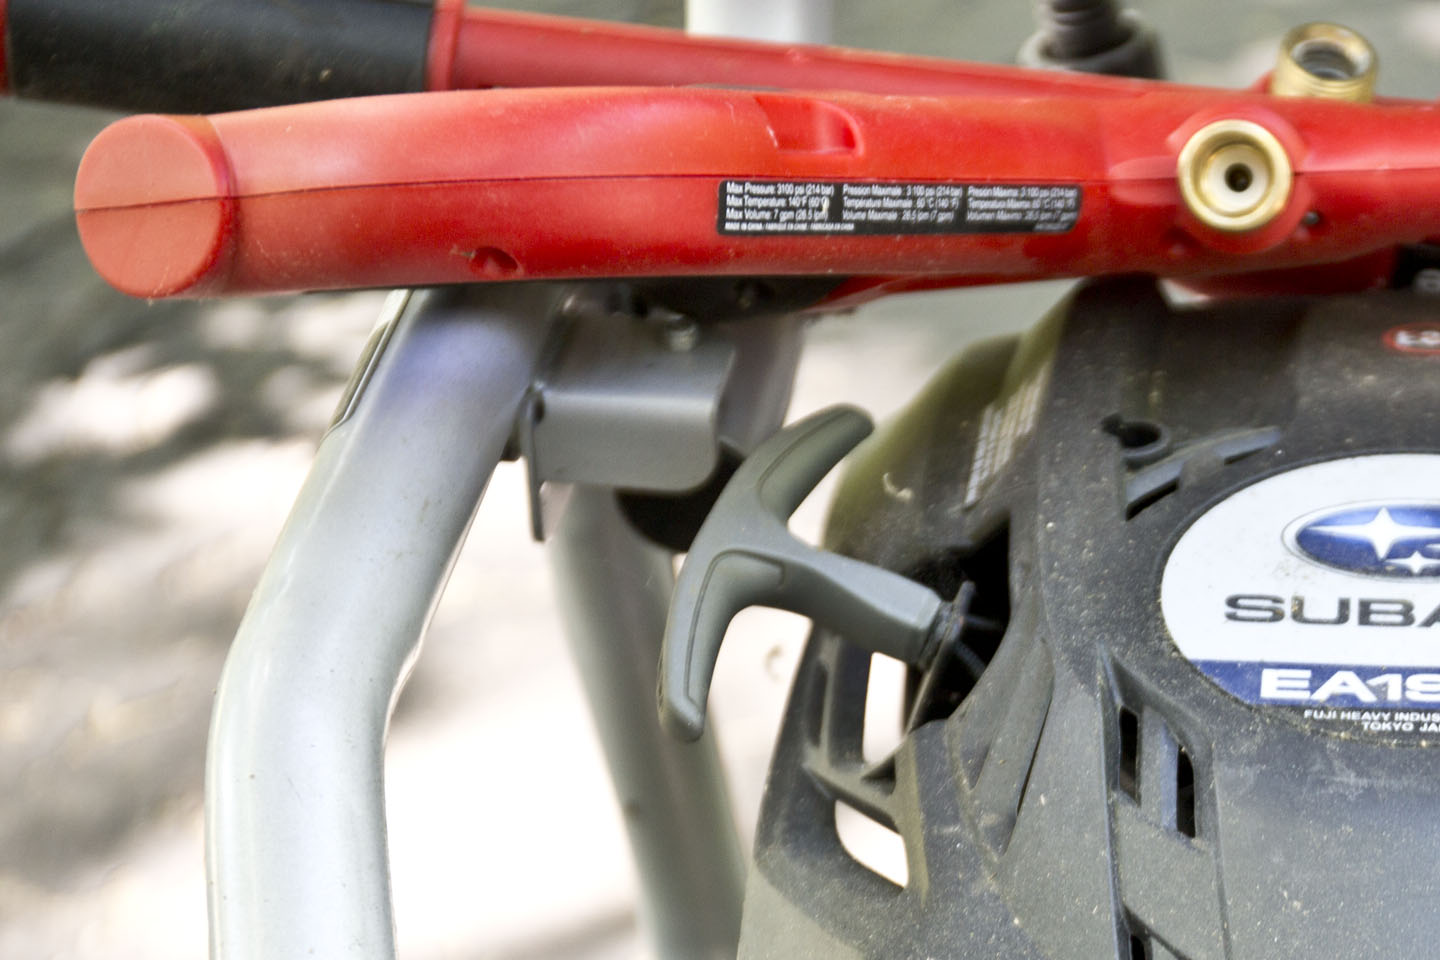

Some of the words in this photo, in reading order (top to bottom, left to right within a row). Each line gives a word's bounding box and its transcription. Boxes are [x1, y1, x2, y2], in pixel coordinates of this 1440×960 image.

[726, 181, 743, 195] Max
[726, 194, 743, 206] Max
[726, 207, 743, 219] Max
[1304, 709, 1337, 720] FUJI
[1340, 710, 1391, 721] HEAVY
[1362, 721, 1414, 732] TOKYO
